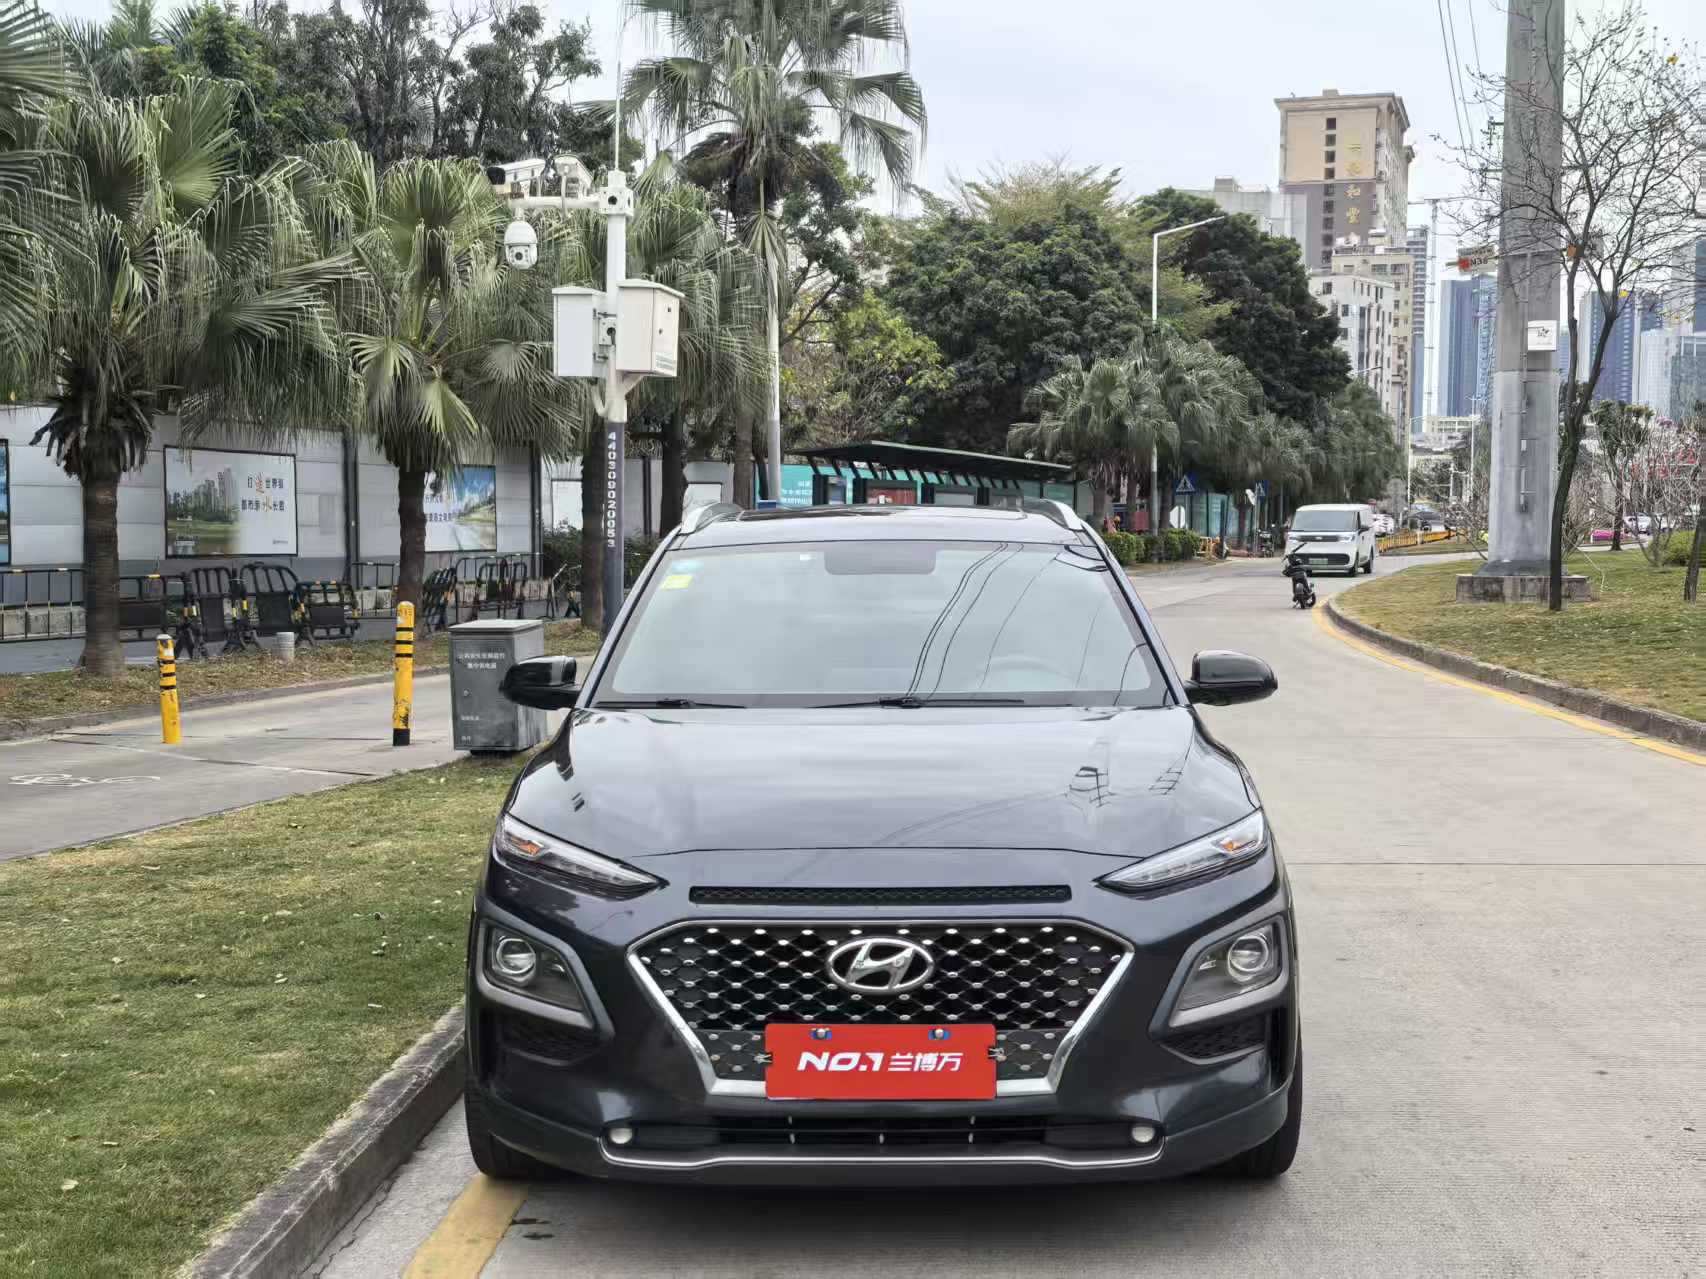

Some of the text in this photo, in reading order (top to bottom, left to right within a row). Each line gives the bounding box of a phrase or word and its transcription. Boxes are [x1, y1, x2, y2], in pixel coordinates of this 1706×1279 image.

[606, 431, 617, 548] 440309020053
[797, 1052, 963, 1072] NO.1 兰博万
